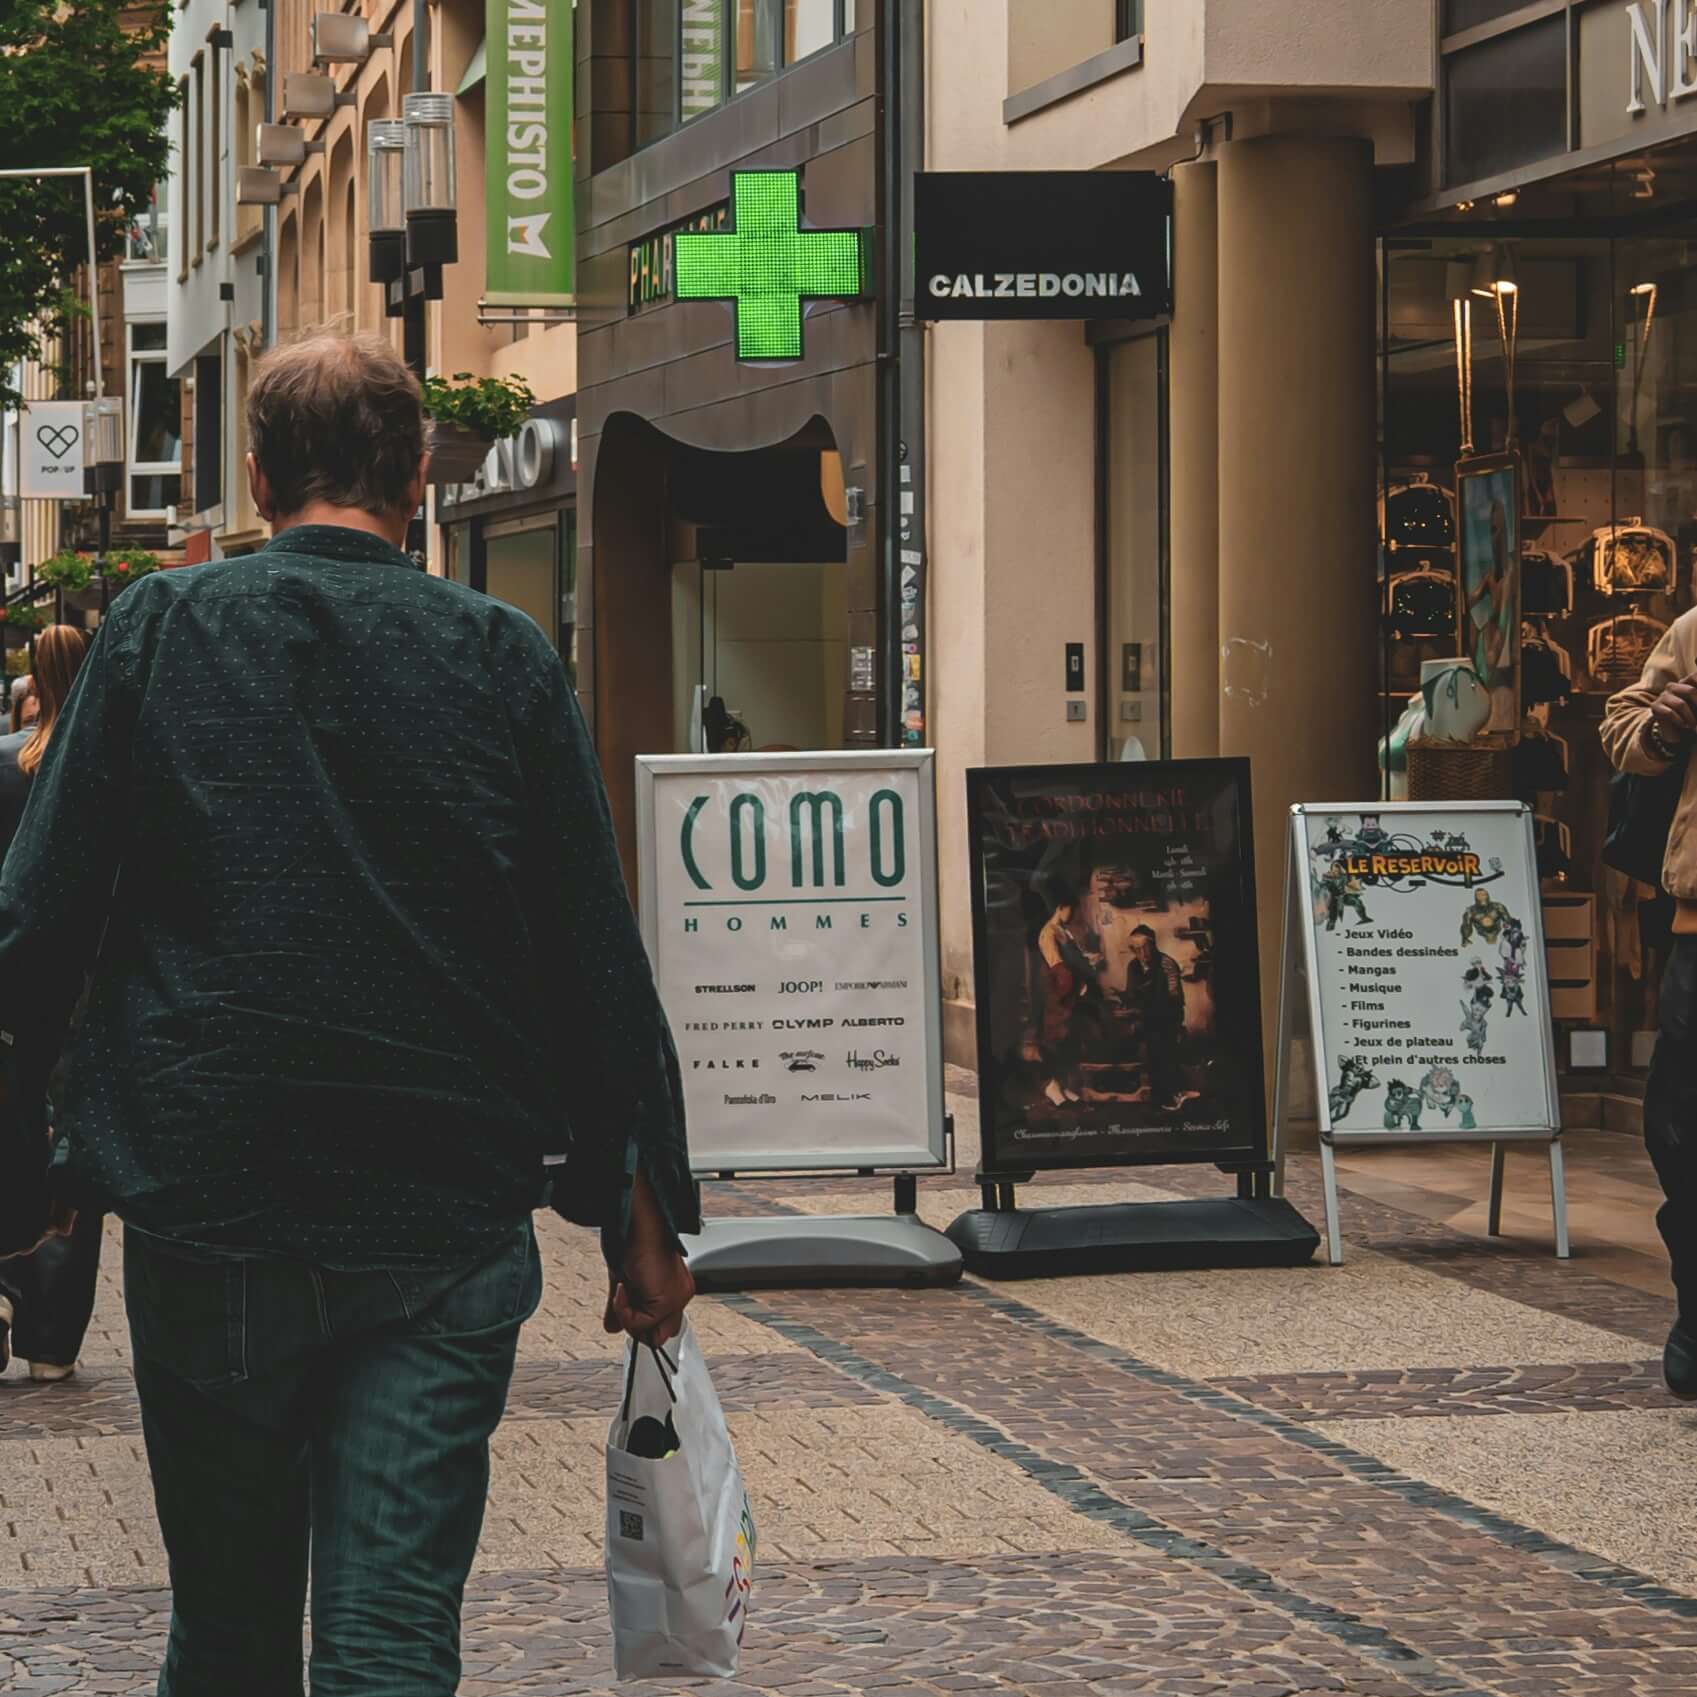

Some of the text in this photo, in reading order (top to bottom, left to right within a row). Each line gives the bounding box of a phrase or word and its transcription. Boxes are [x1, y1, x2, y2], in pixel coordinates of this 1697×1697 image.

[928, 272, 1142, 298] CALZEDONIA
[41, 465, 75, 474] POP UP
[680, 788, 907, 891] COMO
[1347, 856, 1370, 875] LE
[684, 912, 908, 932] HOMMES
[1344, 928, 1414, 940] Jeux Vidéo
[1346, 946, 1459, 957] Bandes dessinées
[1348, 965, 1397, 977] Mangas
[694, 984, 756, 994] STRELLSON
[777, 980, 824, 994] JOOP!
[1349, 983, 1403, 995] Musique
[1351, 1000, 1385, 1011] Films
[685, 1017, 905, 1032] FRED PERRY OLYMP ALBERTO
[1352, 1018, 1411, 1031] Figurines
[1353, 1036, 1454, 1049] Jeux de plateau
[693, 1059, 759, 1069] FALKE
[1355, 1054, 1506, 1068] Et plein d'autres choses
[801, 1093, 872, 1101] MELIK
